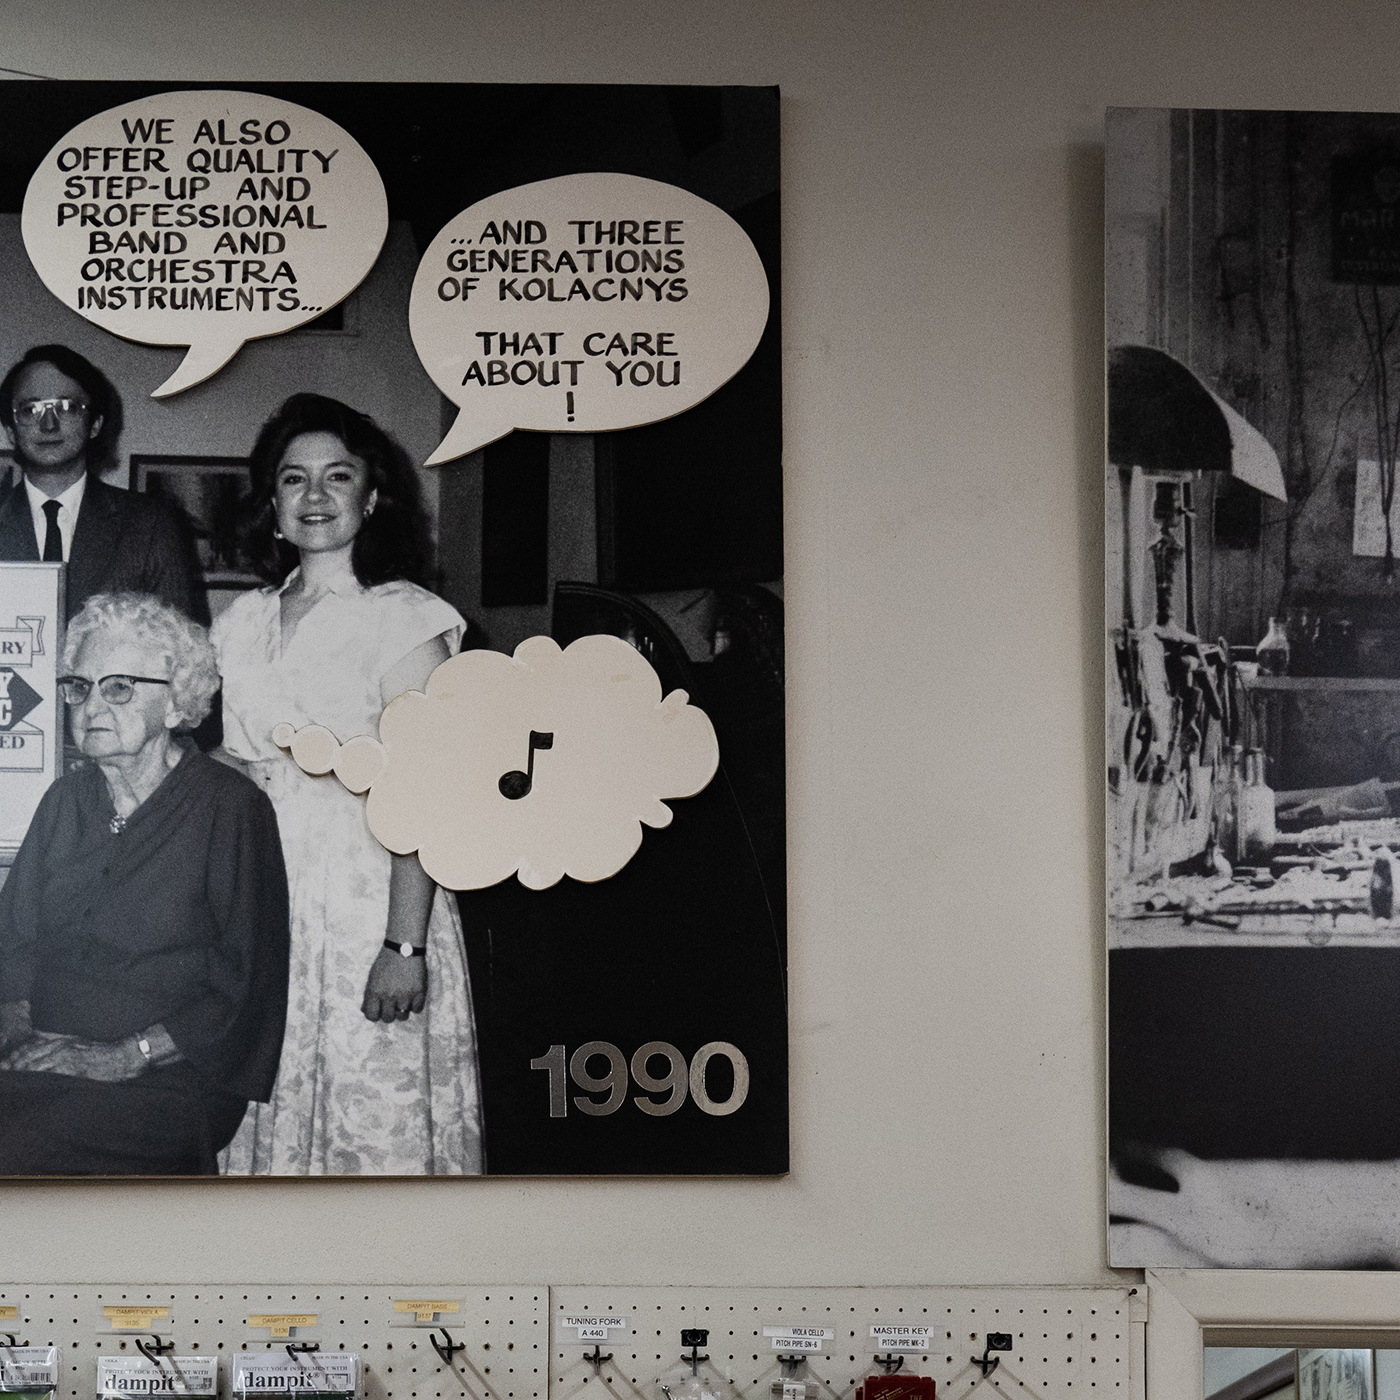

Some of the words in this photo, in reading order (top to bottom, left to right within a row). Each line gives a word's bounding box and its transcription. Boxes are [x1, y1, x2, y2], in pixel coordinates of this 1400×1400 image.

[121, 119, 175, 144] WE
[197, 120, 291, 145] ALSO
[57, 148, 169, 172] OFFER
[186, 148, 340, 173] QUALITY
[64, 176, 211, 200] STEP-UP
[237, 176, 312, 200] AND
[57, 204, 327, 229] PROFESSIONAL
[89, 231, 188, 256] BAND
[214, 231, 286, 256] AND
[567, 220, 685, 245] THREE
[80, 258, 297, 284] ORCHESTRA
[446, 249, 685, 274] GENERATIONS
[78, 286, 324, 312] INSTRUMENTS...
[438, 276, 479, 301] OF
[497, 277, 689, 303] KOLACNYS
[475, 331, 564, 356] THAT
[583, 331, 679, 356] CARE
[462, 360, 585, 387] ABOUT
[606, 360, 681, 387] YOU
[530, 1040, 750, 1118] 1990
[566, 1318, 596, 1326] TUNING
[874, 1327, 908, 1336] MASTER
[909, 1326, 929, 1336] KEY
